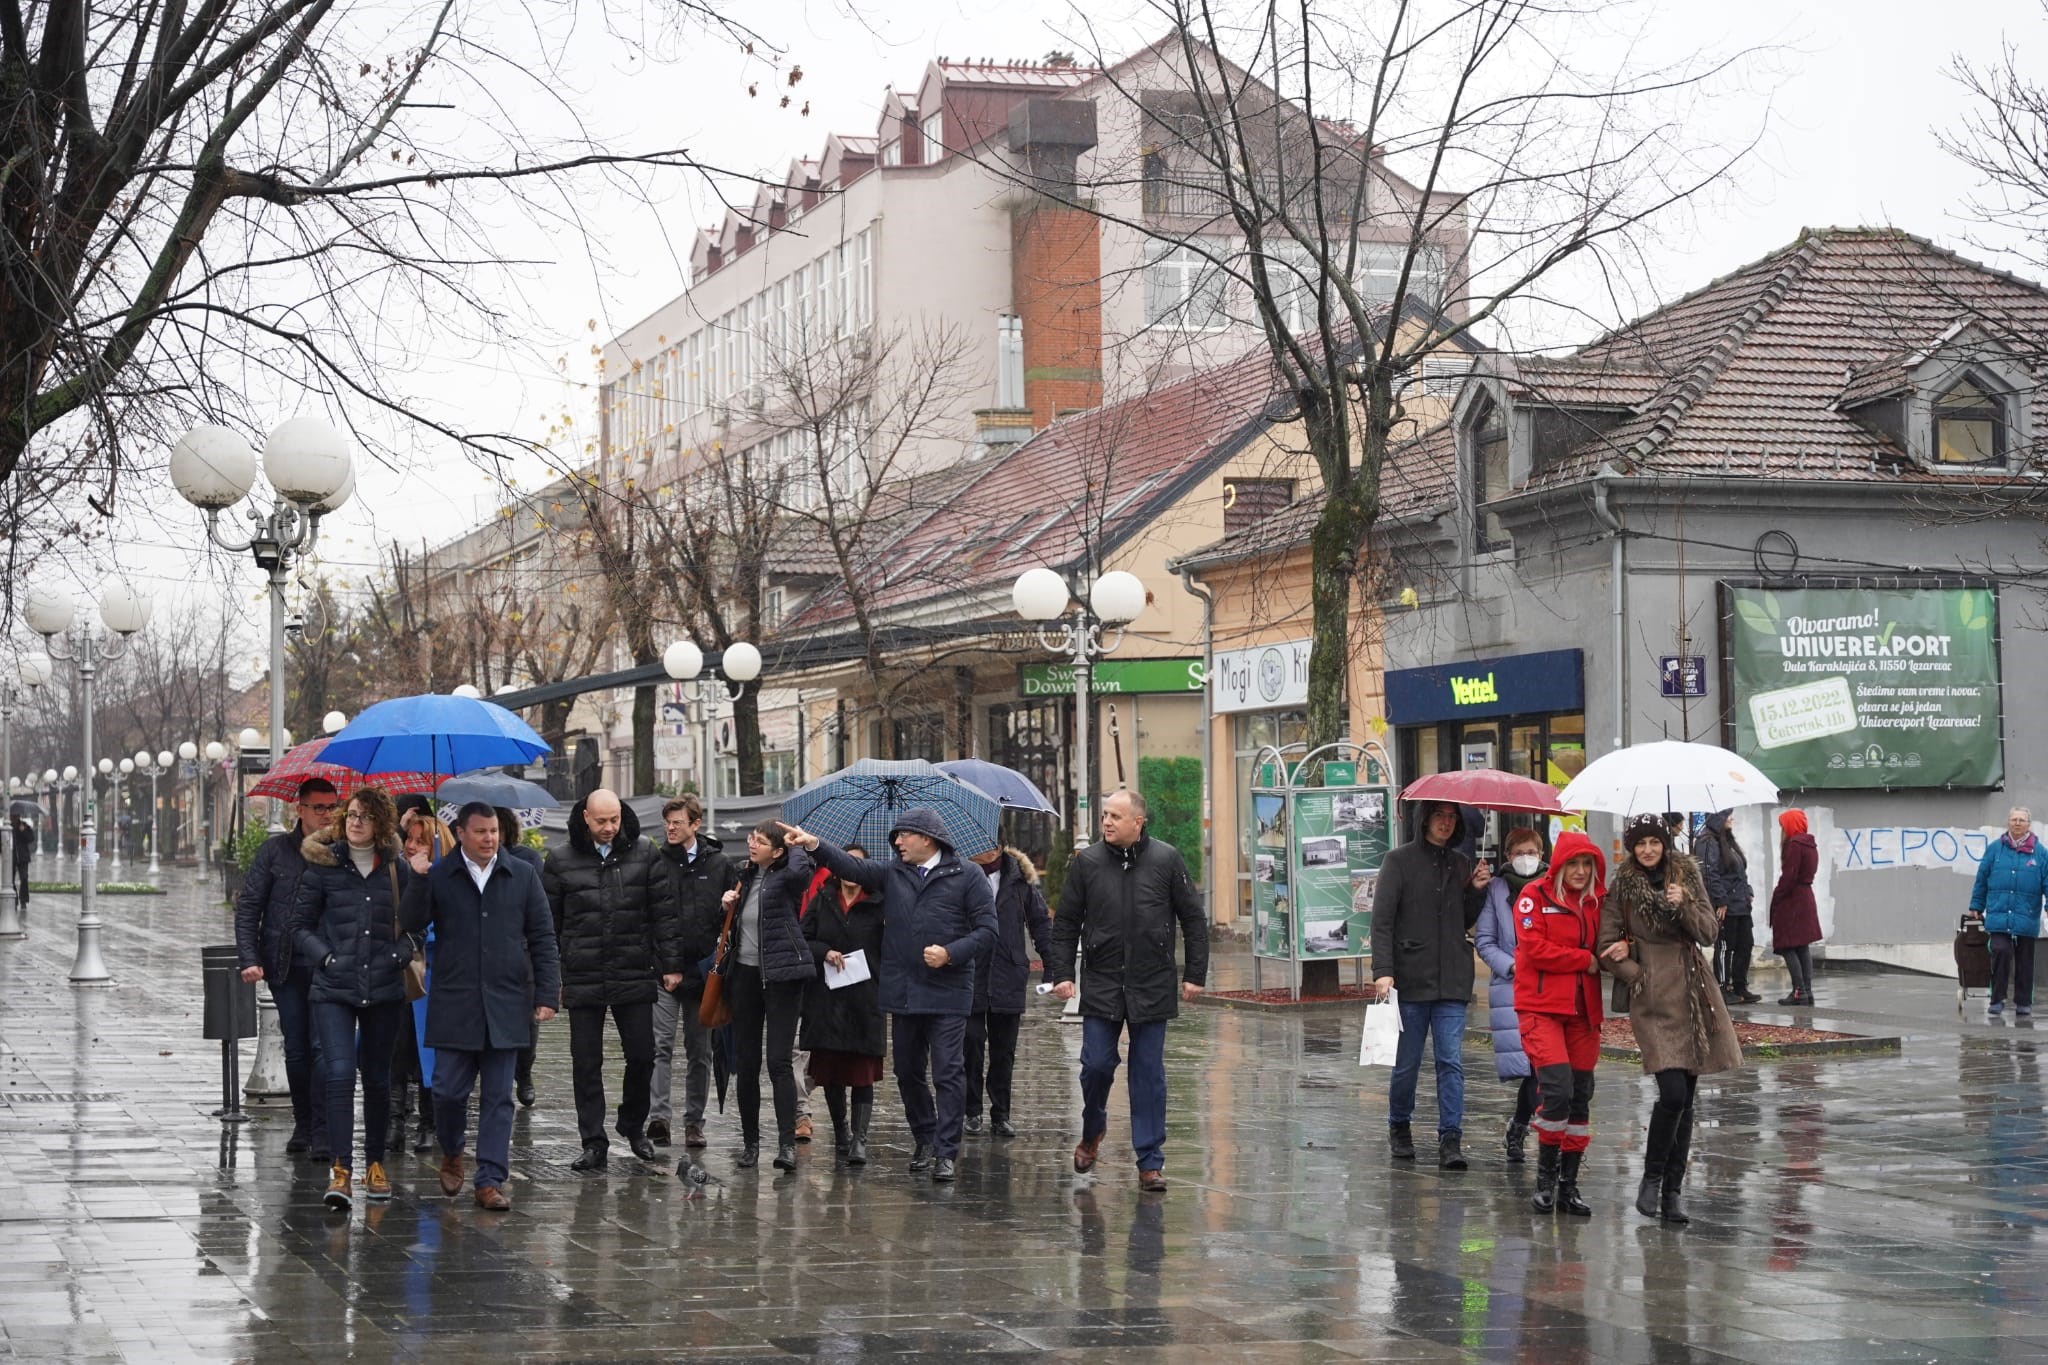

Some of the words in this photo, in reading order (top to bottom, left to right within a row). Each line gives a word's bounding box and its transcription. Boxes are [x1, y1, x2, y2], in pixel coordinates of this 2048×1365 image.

[1787, 607, 1879, 636] Otvaramo!
[1780, 627, 1951, 657] UNIVEREXPORT
[1046, 665, 1097, 681] Swet
[1221, 657, 1251, 703] Mogi
[1293, 647, 1307, 684] Ki
[1808, 660, 1866, 675] Karaklajića
[1868, 659, 1878, 673] 8,
[1880, 659, 1907, 671] 11550
[1908, 659, 1952, 674] Lazarevac
[1856, 682, 1895, 697] Štedimo
[1898, 687, 1917, 697] vam
[1919, 687, 1945, 697] vreme
[1946, 685, 1951, 697] i
[1759, 689, 1846, 723] 15.12.2022.
[1857, 702, 1889, 713] otvara
[1890, 703, 1900, 713] se
[1899, 701, 1914, 715] još
[1914, 701, 1942, 715] jedan
[1858, 714, 1925, 731] Univerexport
[1926, 714, 1981, 731] Lazarevac!
